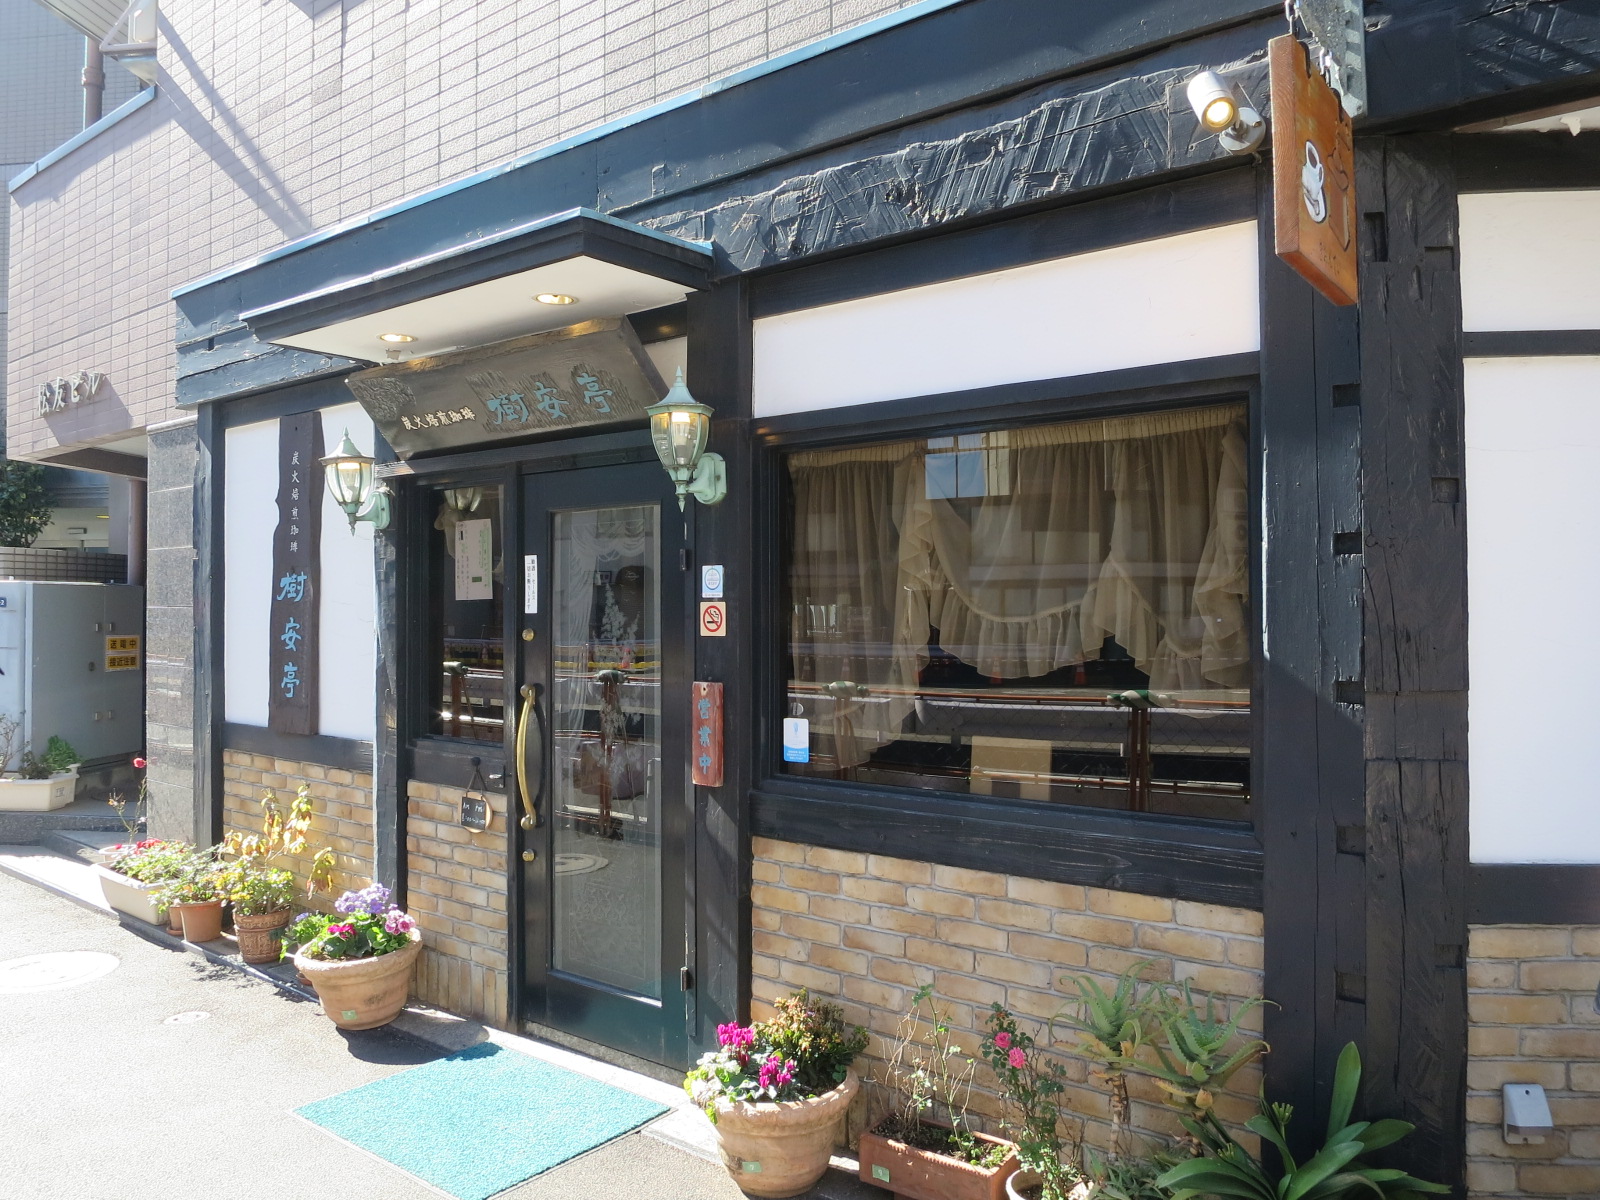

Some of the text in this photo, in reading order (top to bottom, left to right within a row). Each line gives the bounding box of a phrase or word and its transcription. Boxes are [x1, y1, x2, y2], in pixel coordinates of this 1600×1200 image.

[38, 369, 102, 417] 松友ビル
[486, 372, 613, 425] 樹安亭
[400, 406, 477, 432] 炭火焙煎珈琲
[289, 450, 301, 553] 炭火焙煎珈琲
[277, 571, 308, 698] 樹安亭
[109, 656, 137, 667] 接近注意
